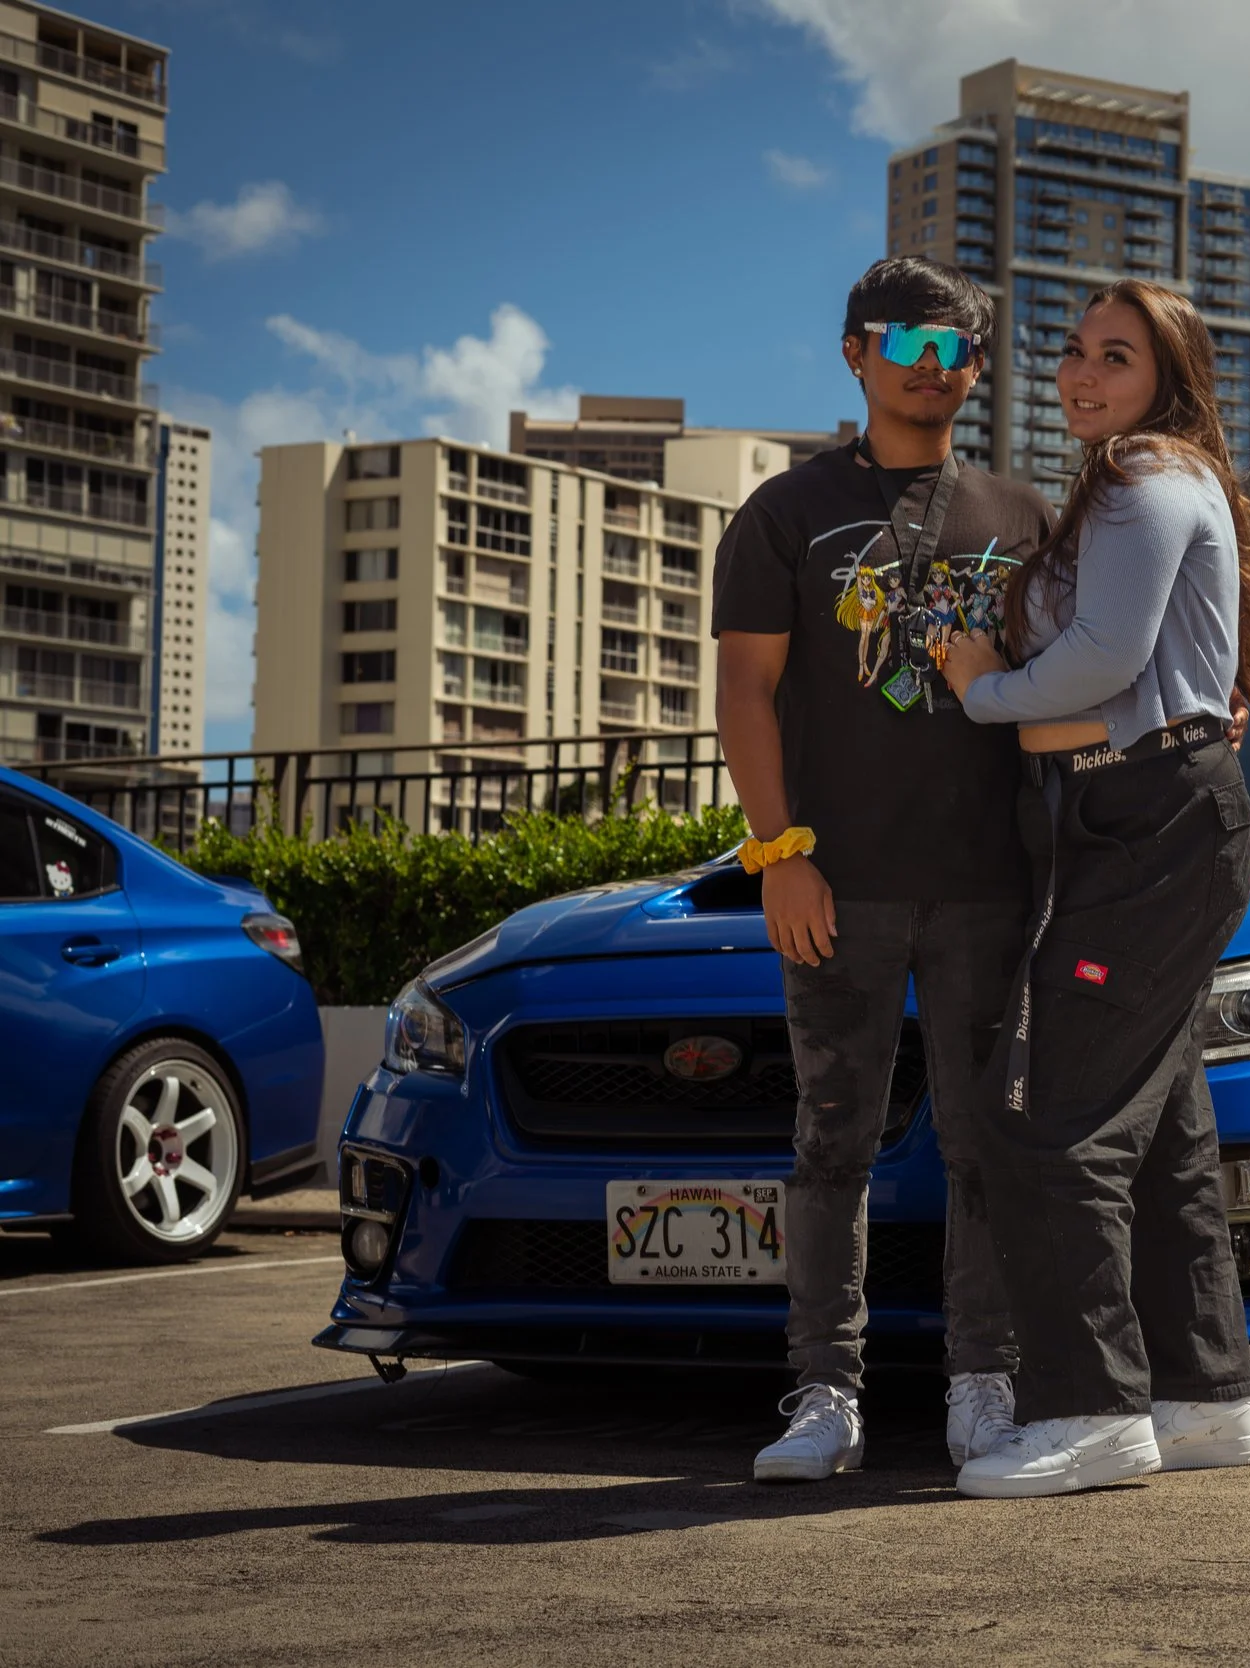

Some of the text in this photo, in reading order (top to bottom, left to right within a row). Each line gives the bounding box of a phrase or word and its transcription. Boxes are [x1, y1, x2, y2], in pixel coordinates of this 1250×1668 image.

[669, 1187, 722, 1201] HAWAII
[756, 1188, 772, 1198] SEP
[615, 1205, 780, 1260] SZC 314
[655, 1265, 742, 1278] ALOHA STATE
